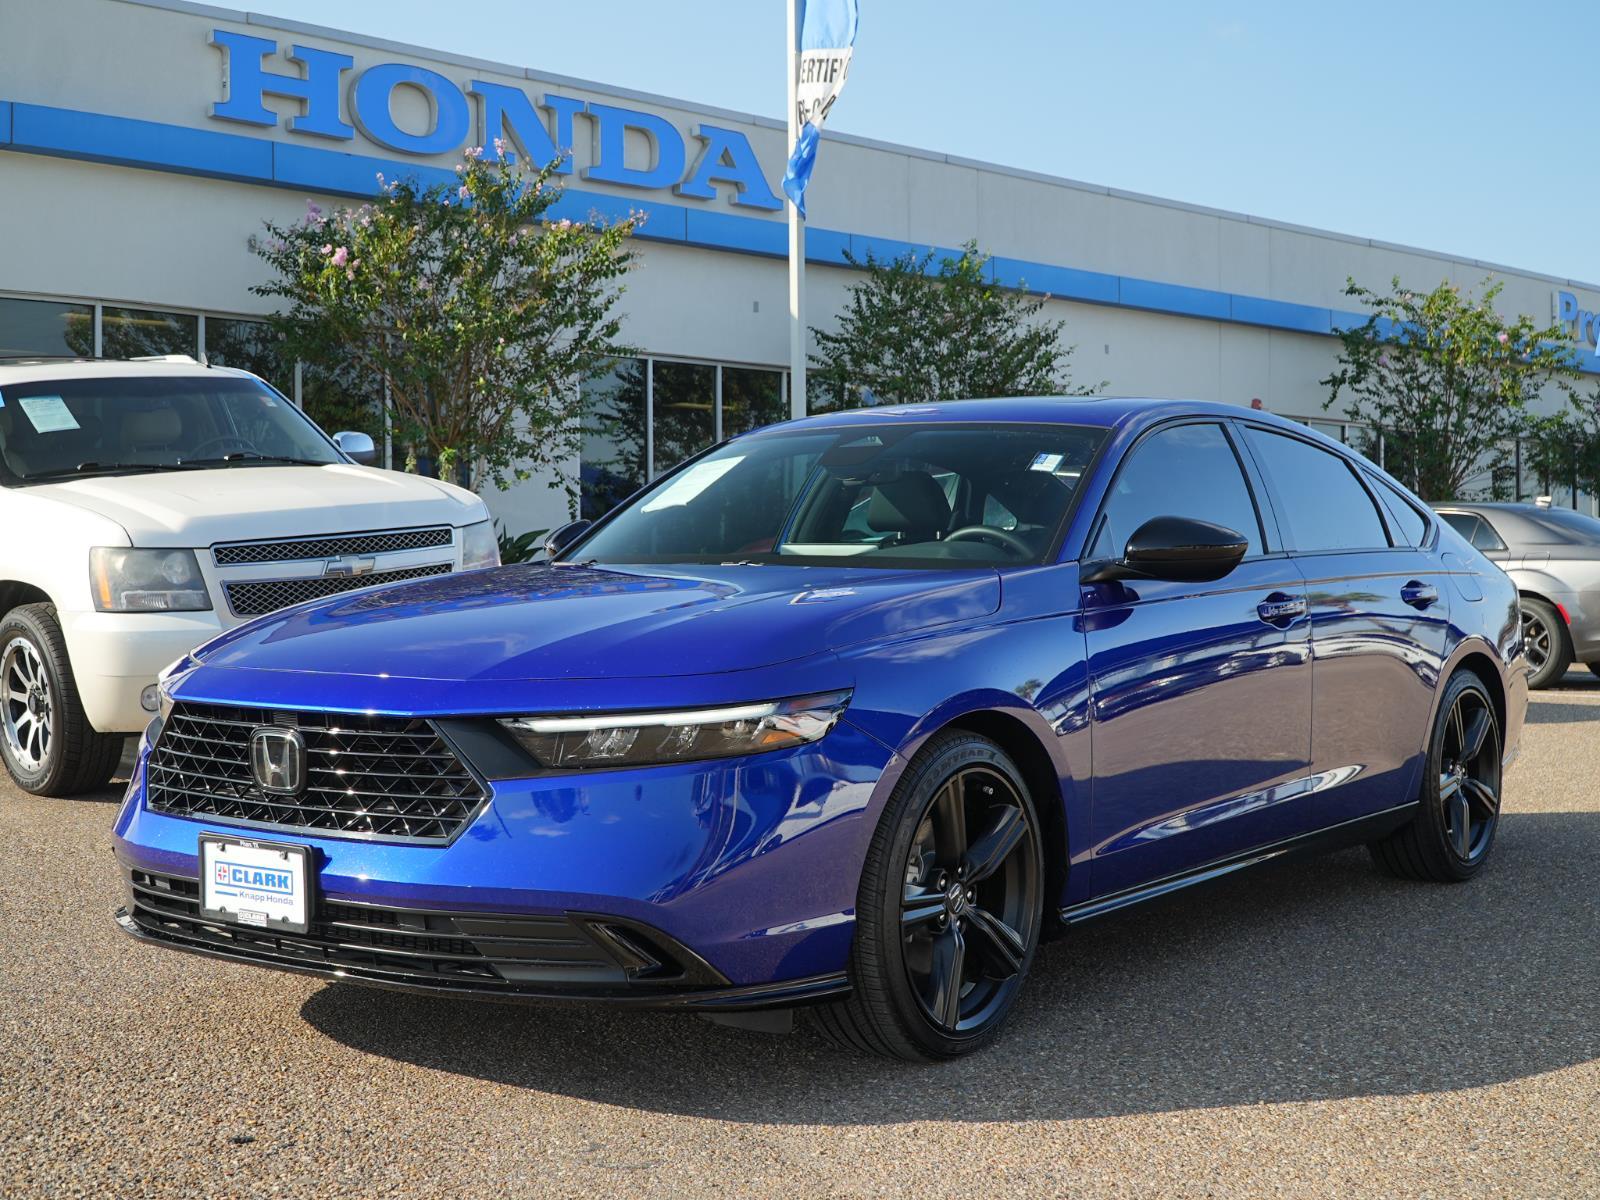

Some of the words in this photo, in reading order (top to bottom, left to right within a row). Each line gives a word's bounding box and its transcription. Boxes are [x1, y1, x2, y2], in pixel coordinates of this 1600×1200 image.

[801, 58, 847, 83] ERTIF
[208, 29, 783, 211] HONDA
[232, 868, 289, 889] CLARK
[239, 891, 265, 903] Knapp
[266, 894, 294, 905] Honda
